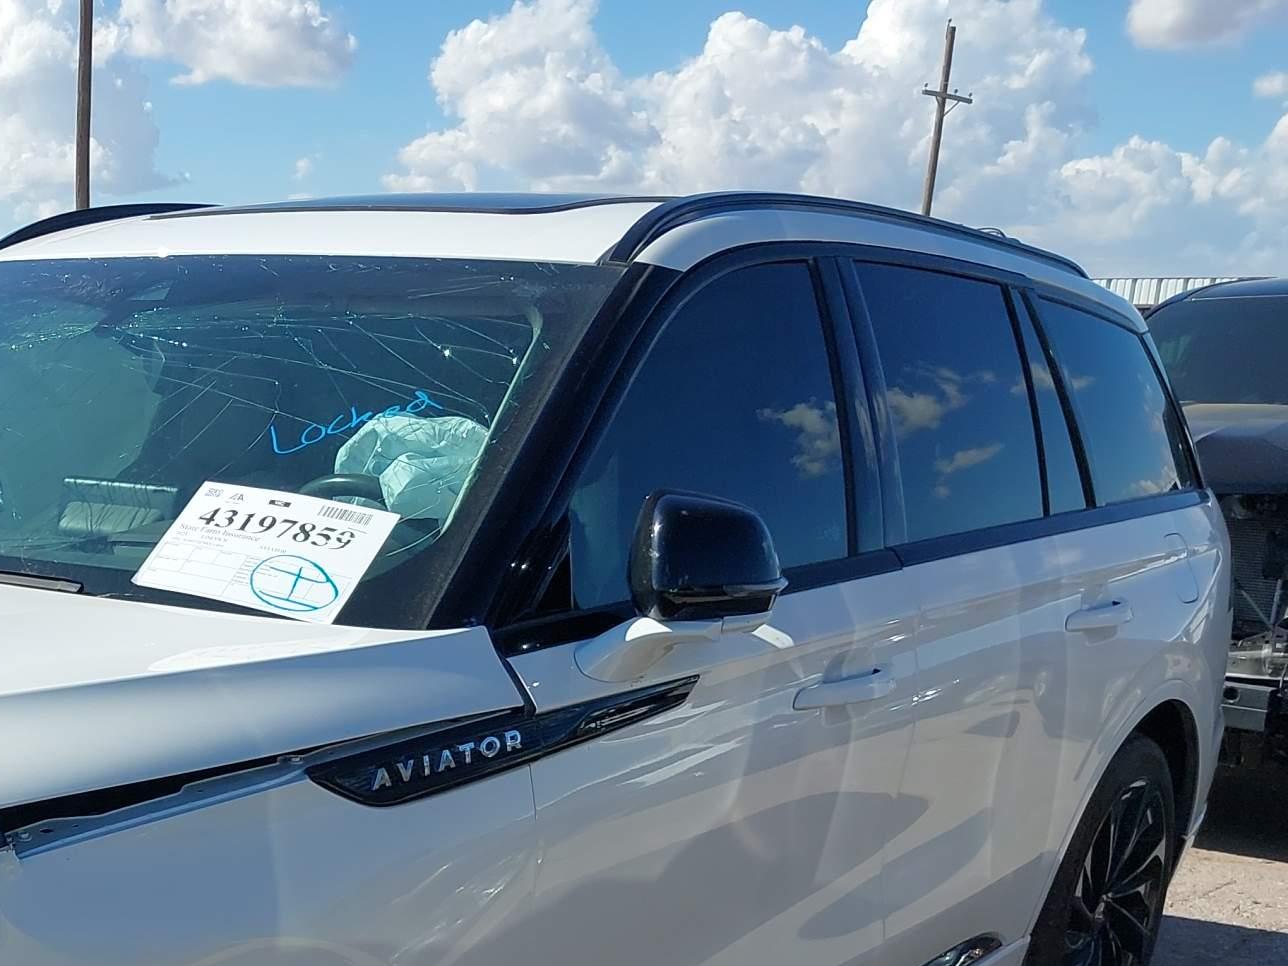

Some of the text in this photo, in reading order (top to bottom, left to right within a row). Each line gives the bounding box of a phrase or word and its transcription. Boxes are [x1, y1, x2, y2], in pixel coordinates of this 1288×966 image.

[270, 390, 443, 455] Locked
[198, 507, 356, 550] 43197859
[372, 729, 523, 791] AVIATOR
